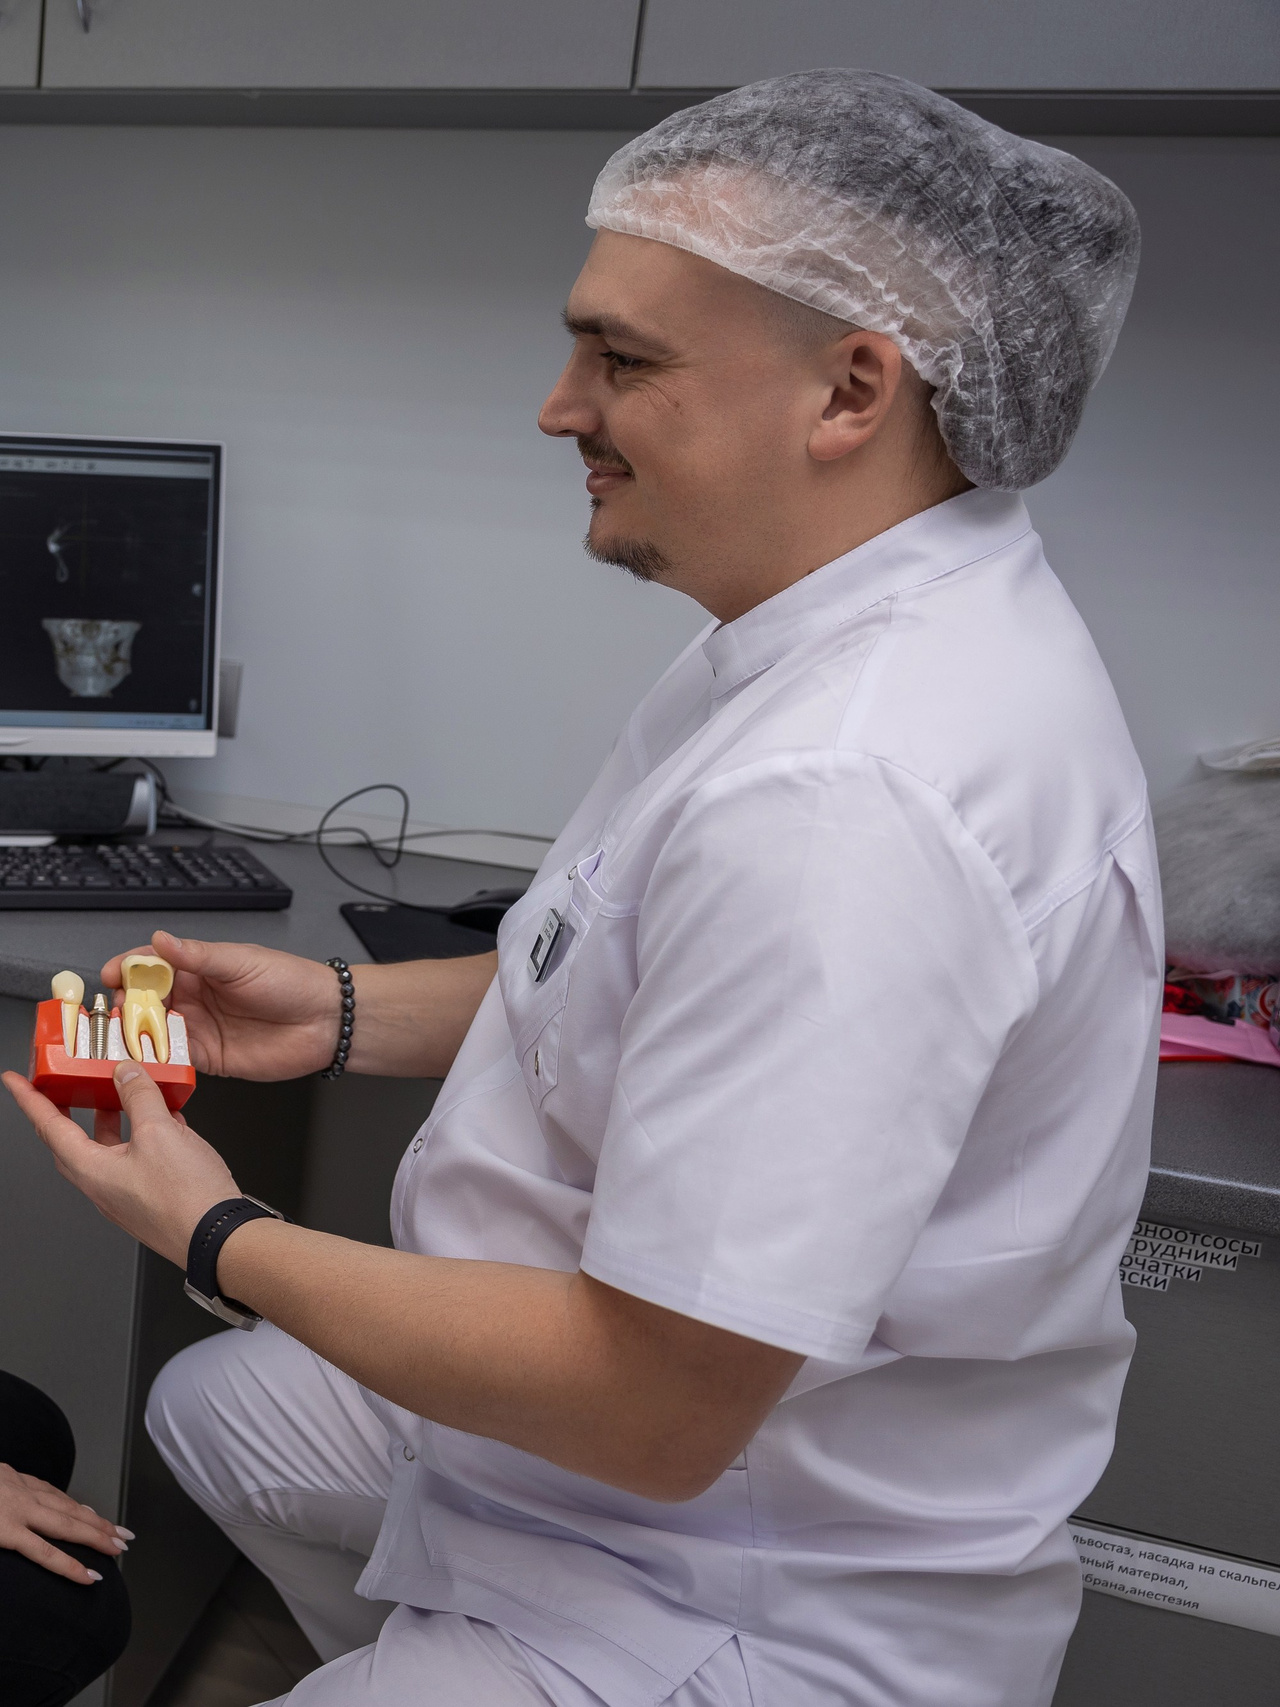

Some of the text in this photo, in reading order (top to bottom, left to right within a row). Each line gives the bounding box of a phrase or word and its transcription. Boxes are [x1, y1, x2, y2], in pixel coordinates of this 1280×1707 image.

[1130, 1238, 1238, 1268] рудники
[1138, 1550, 1194, 1569] насадка
[1199, 1560, 1215, 1575] на
[1118, 1565, 1189, 1590] материал,
[1082, 1574, 1200, 1609] брана,анестезия
